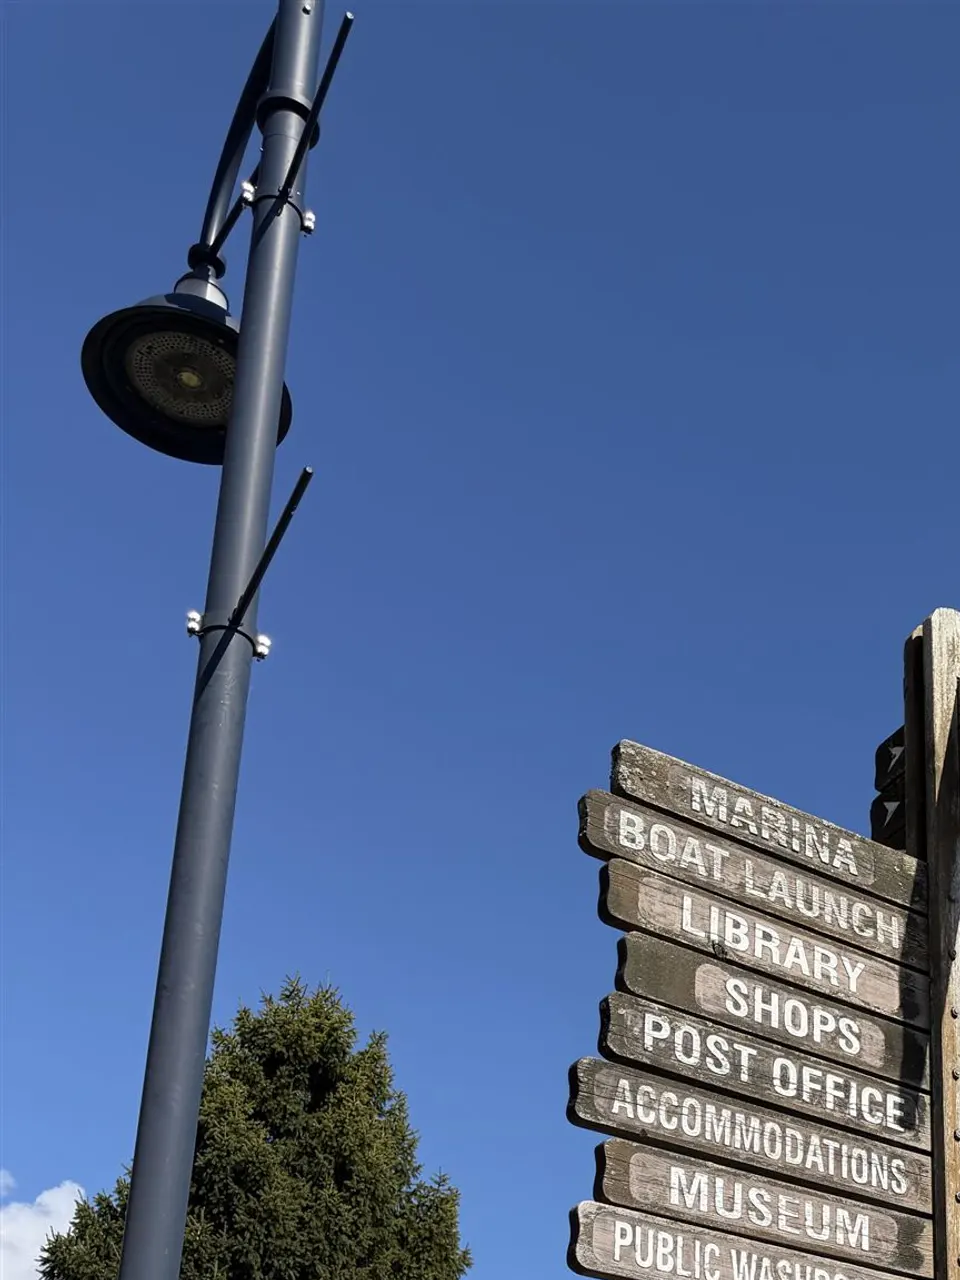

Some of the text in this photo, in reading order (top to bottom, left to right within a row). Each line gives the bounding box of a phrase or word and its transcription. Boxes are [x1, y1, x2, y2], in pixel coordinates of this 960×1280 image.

[690, 775, 860, 877] MARINA
[618, 808, 901, 950] BOAT LAUNCH
[680, 895, 866, 994] LIBRARY
[724, 977, 862, 1057] SHOPS
[643, 1012, 906, 1133] POST OFFICE
[611, 1078, 909, 1196] ACCOMMODATIONS
[668, 1165, 871, 1252] MUSEUM
